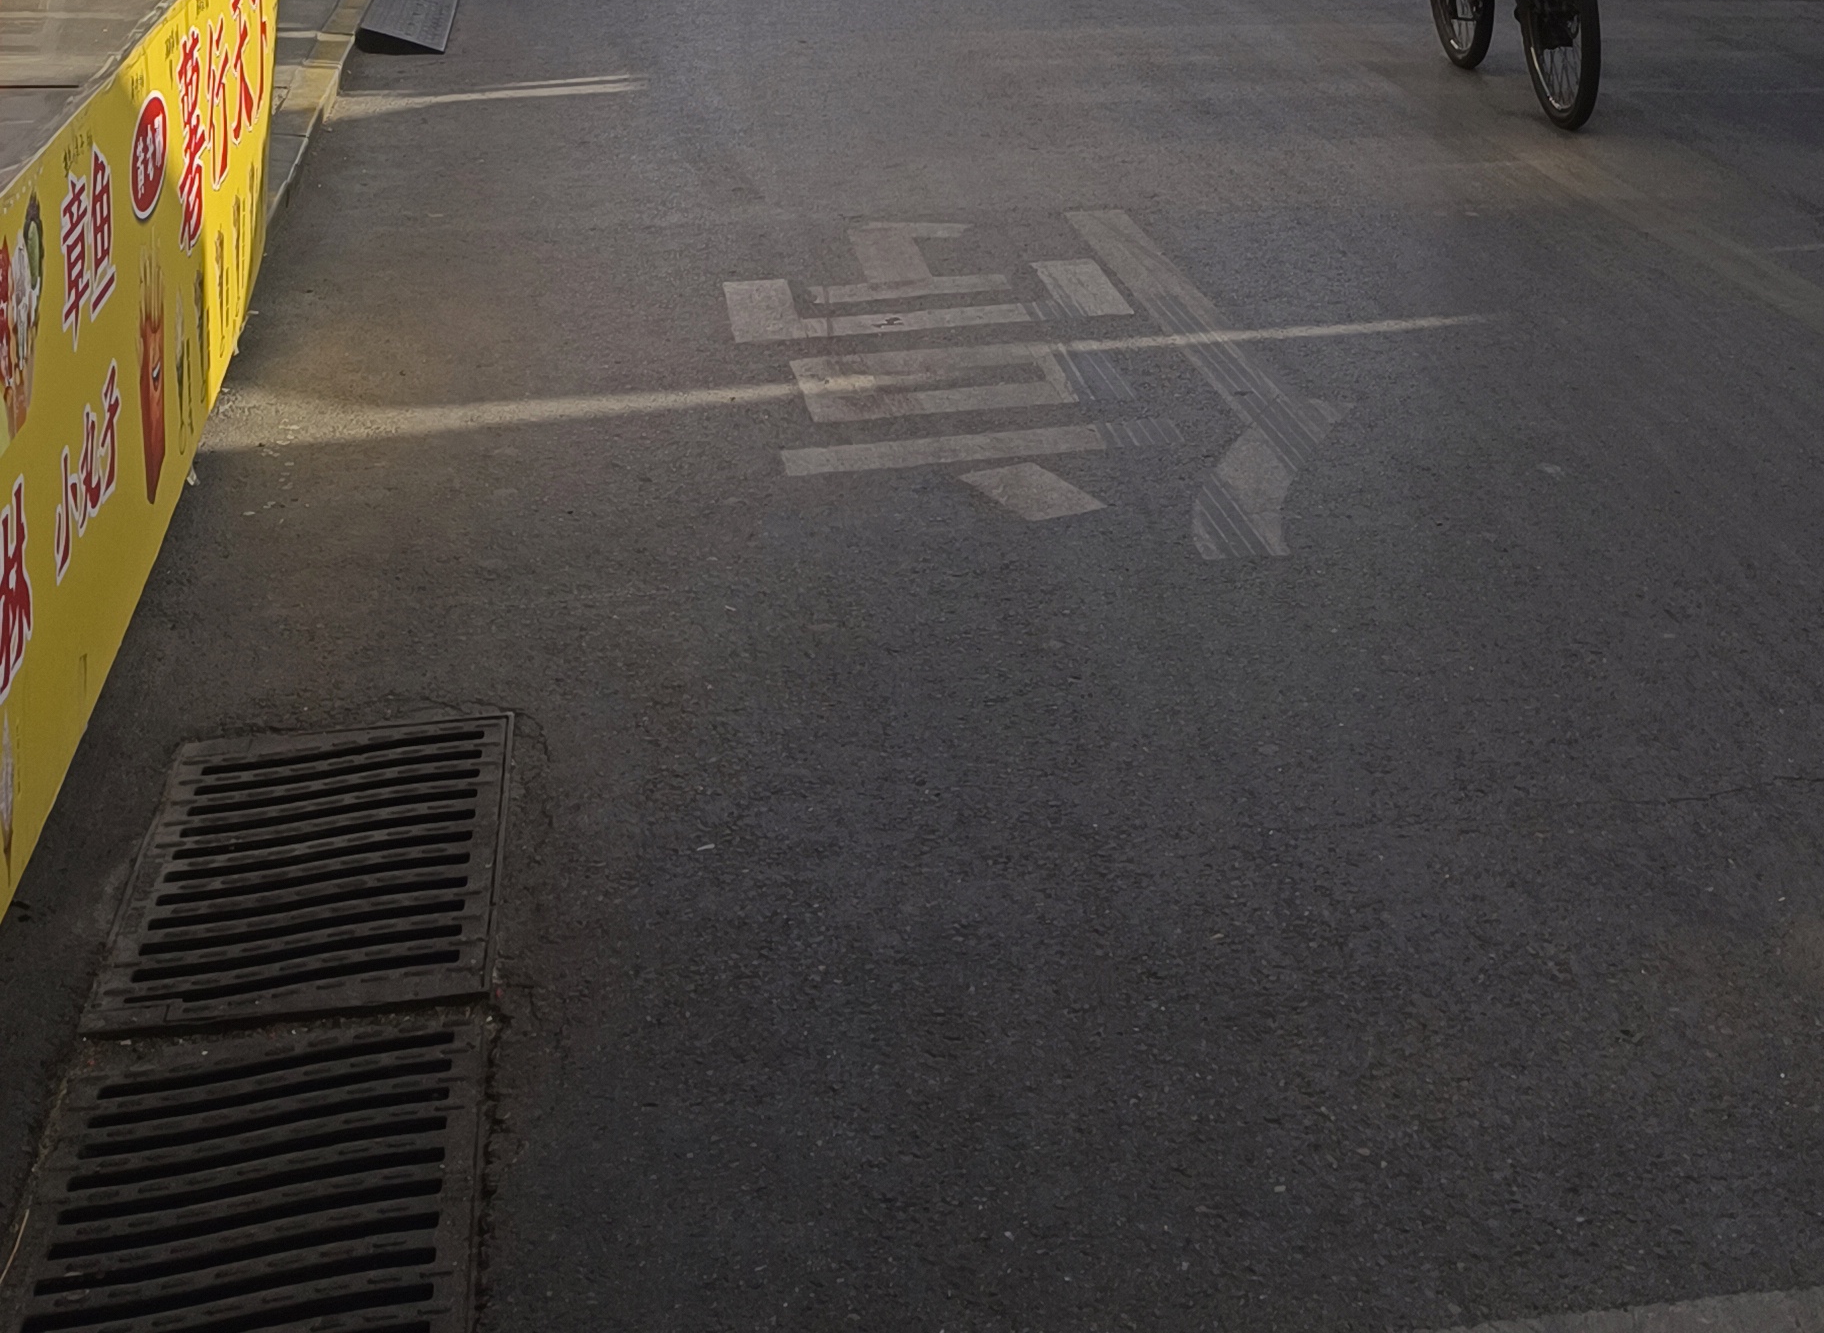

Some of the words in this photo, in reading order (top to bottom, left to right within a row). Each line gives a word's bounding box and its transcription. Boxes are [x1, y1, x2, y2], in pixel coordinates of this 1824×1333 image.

[60, 143, 116, 346] 章鱼
[55, 359, 120, 585] 小丸子
